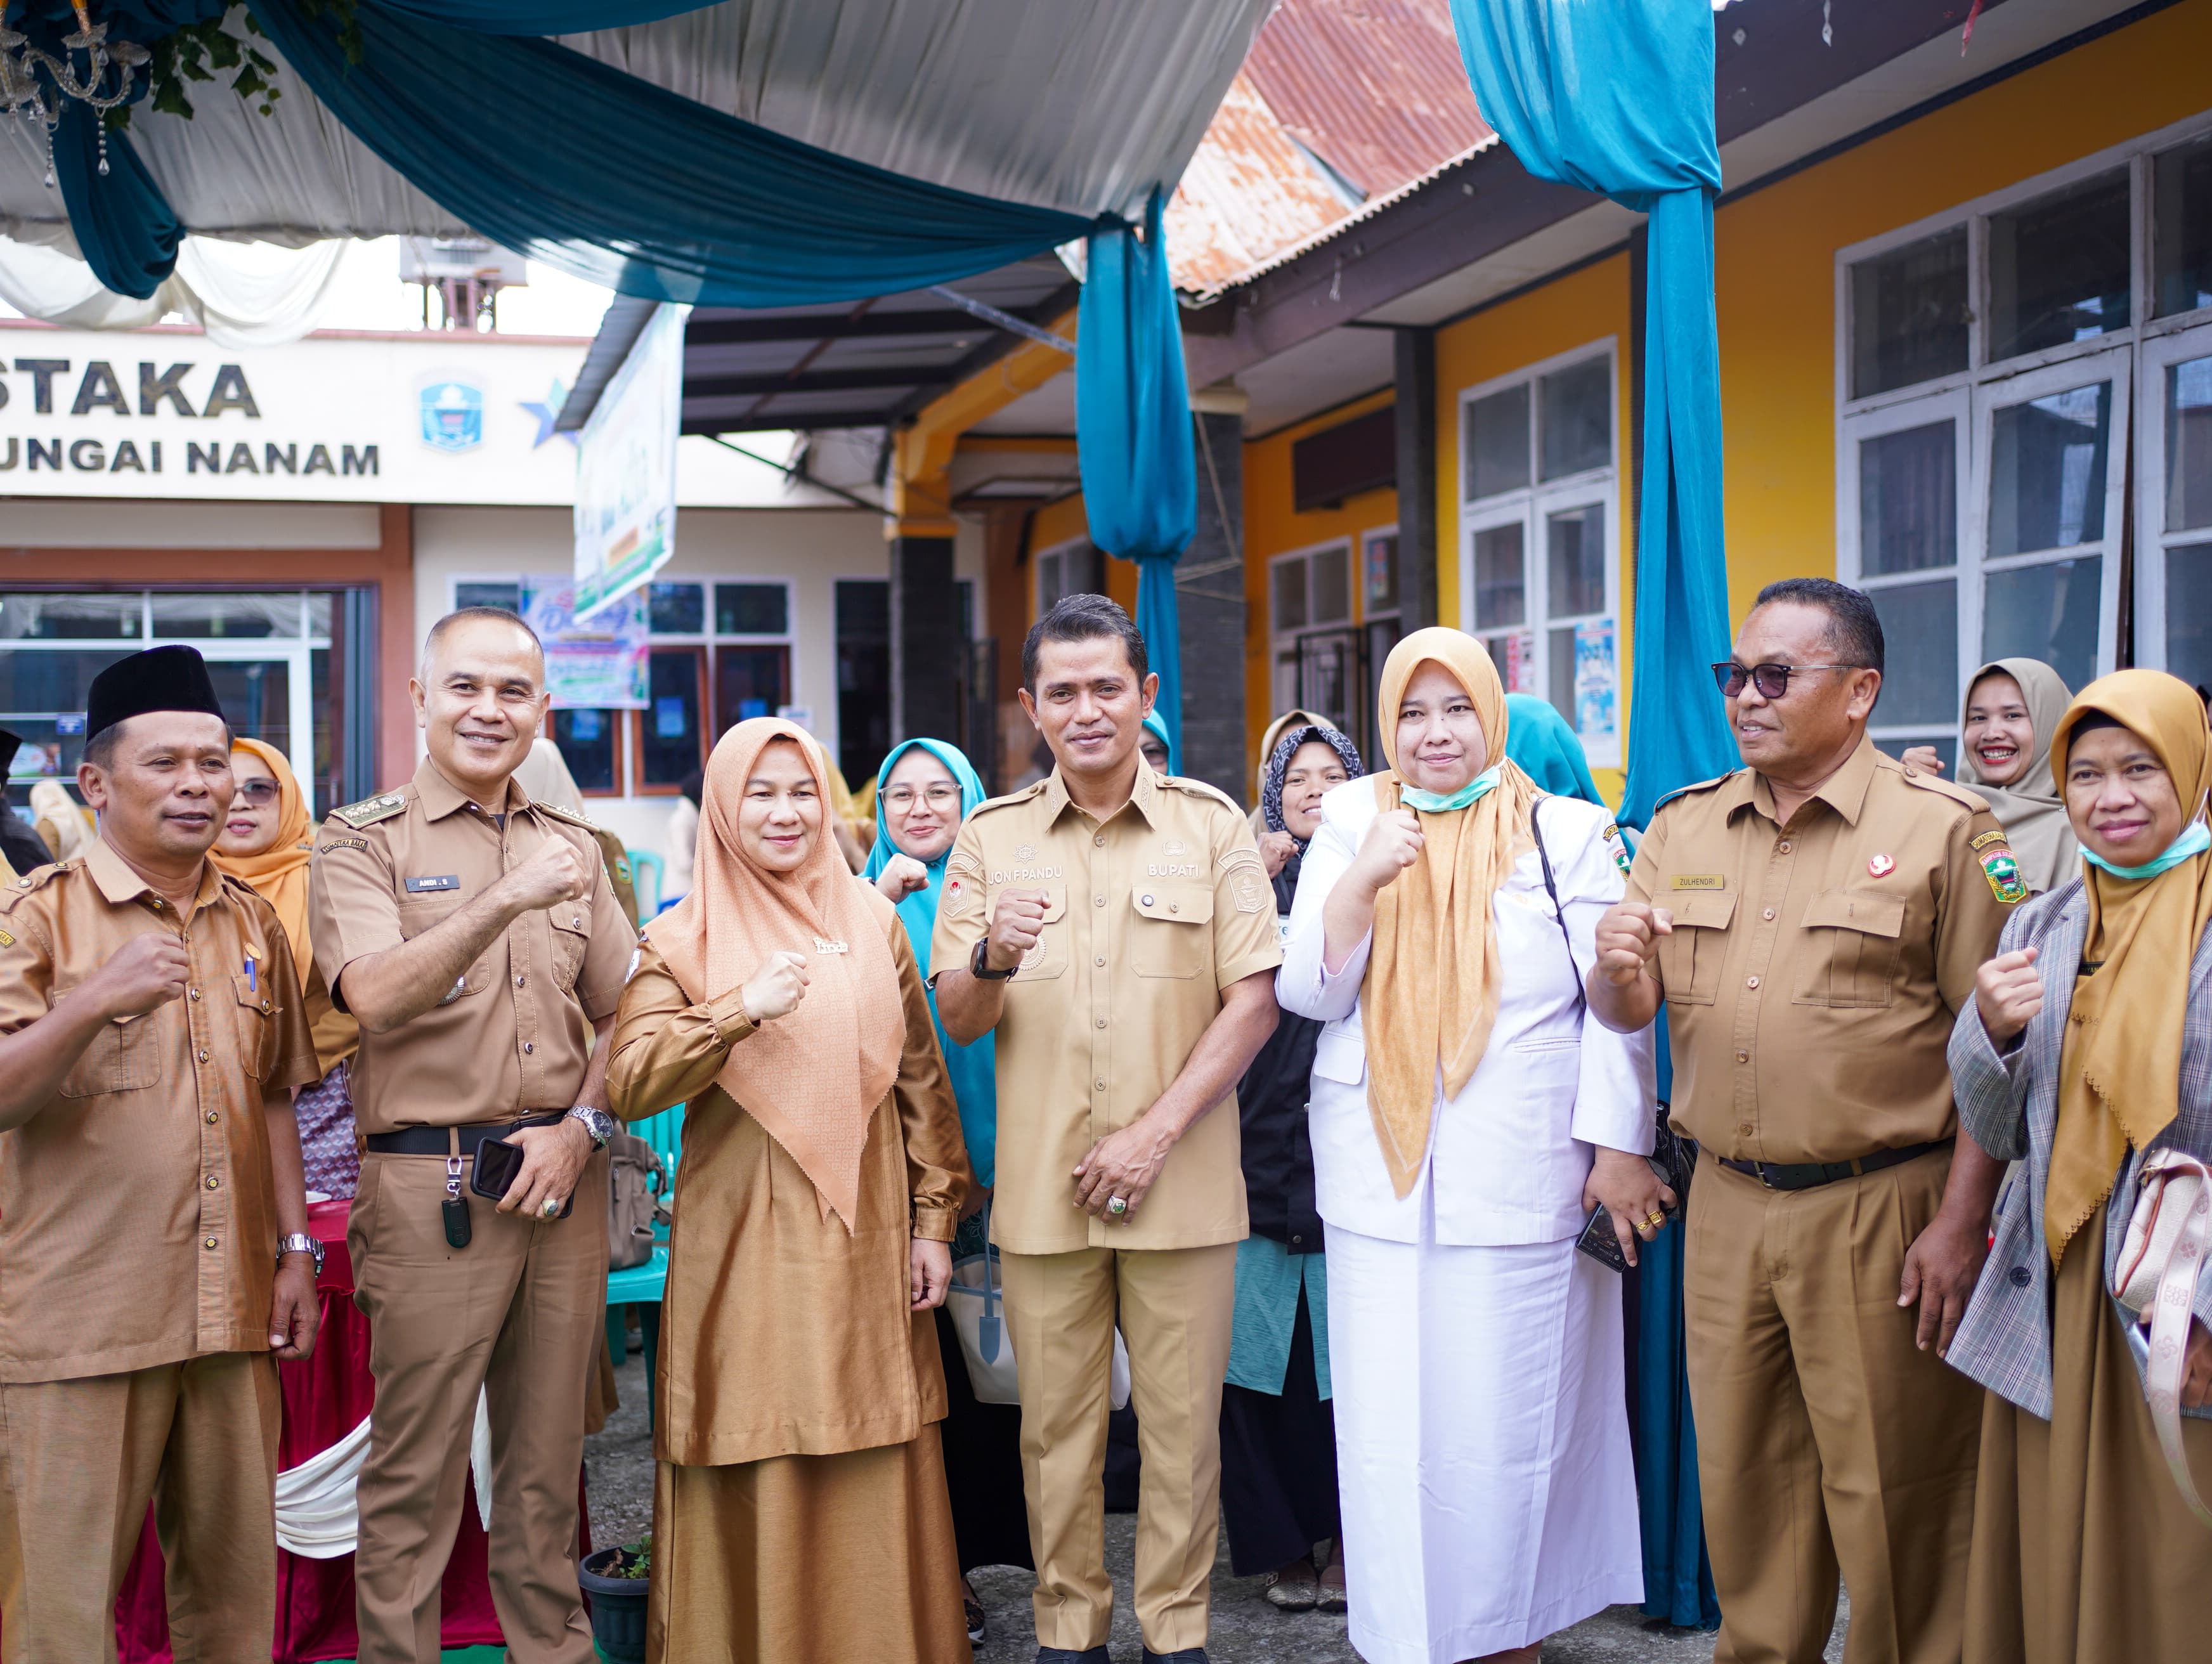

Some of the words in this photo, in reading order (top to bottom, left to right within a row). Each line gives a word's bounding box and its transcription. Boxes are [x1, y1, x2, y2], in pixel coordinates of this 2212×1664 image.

[0, 357, 261, 419] TAKA
[186, 441, 380, 476] NANAM
[989, 870, 1012, 885] JON
[1013, 869, 1020, 881] F
[1022, 865, 1063, 881] PANDU
[1148, 864, 1199, 877] BUPATI
